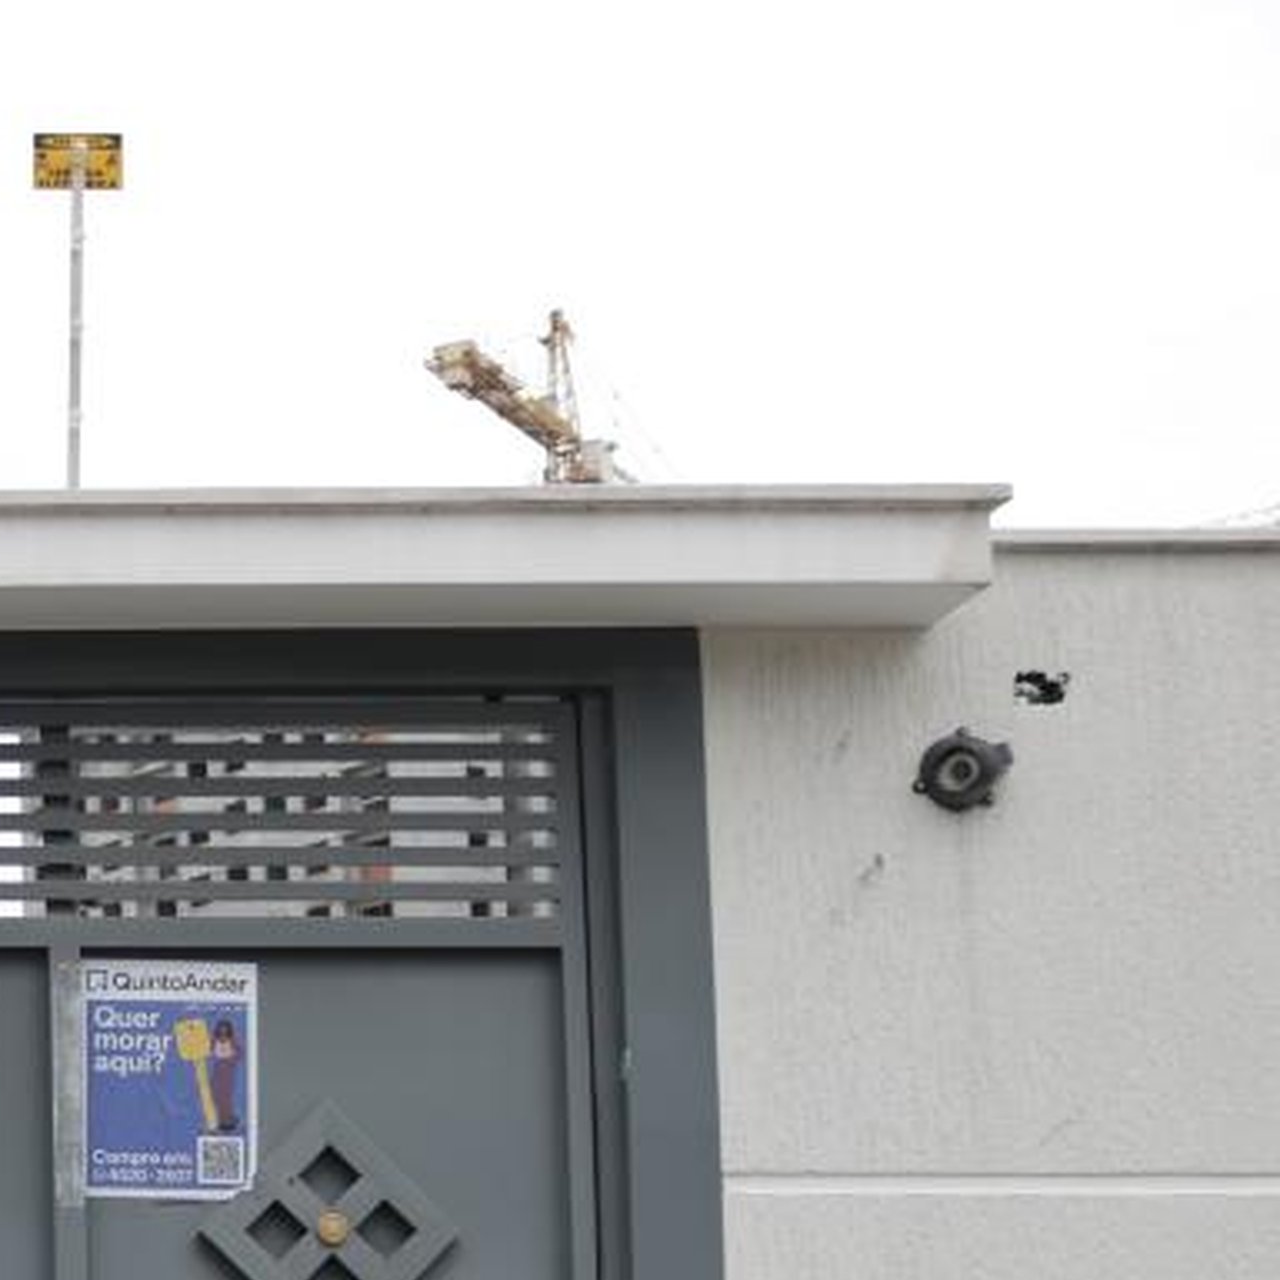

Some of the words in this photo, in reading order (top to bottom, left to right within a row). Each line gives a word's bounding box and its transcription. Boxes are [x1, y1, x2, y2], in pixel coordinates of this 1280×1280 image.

[112, 972, 249, 993] QuintoAndar
[94, 1005, 160, 1029] Quer
[94, 1031, 171, 1051] morar
[94, 1053, 165, 1077] aqui?
